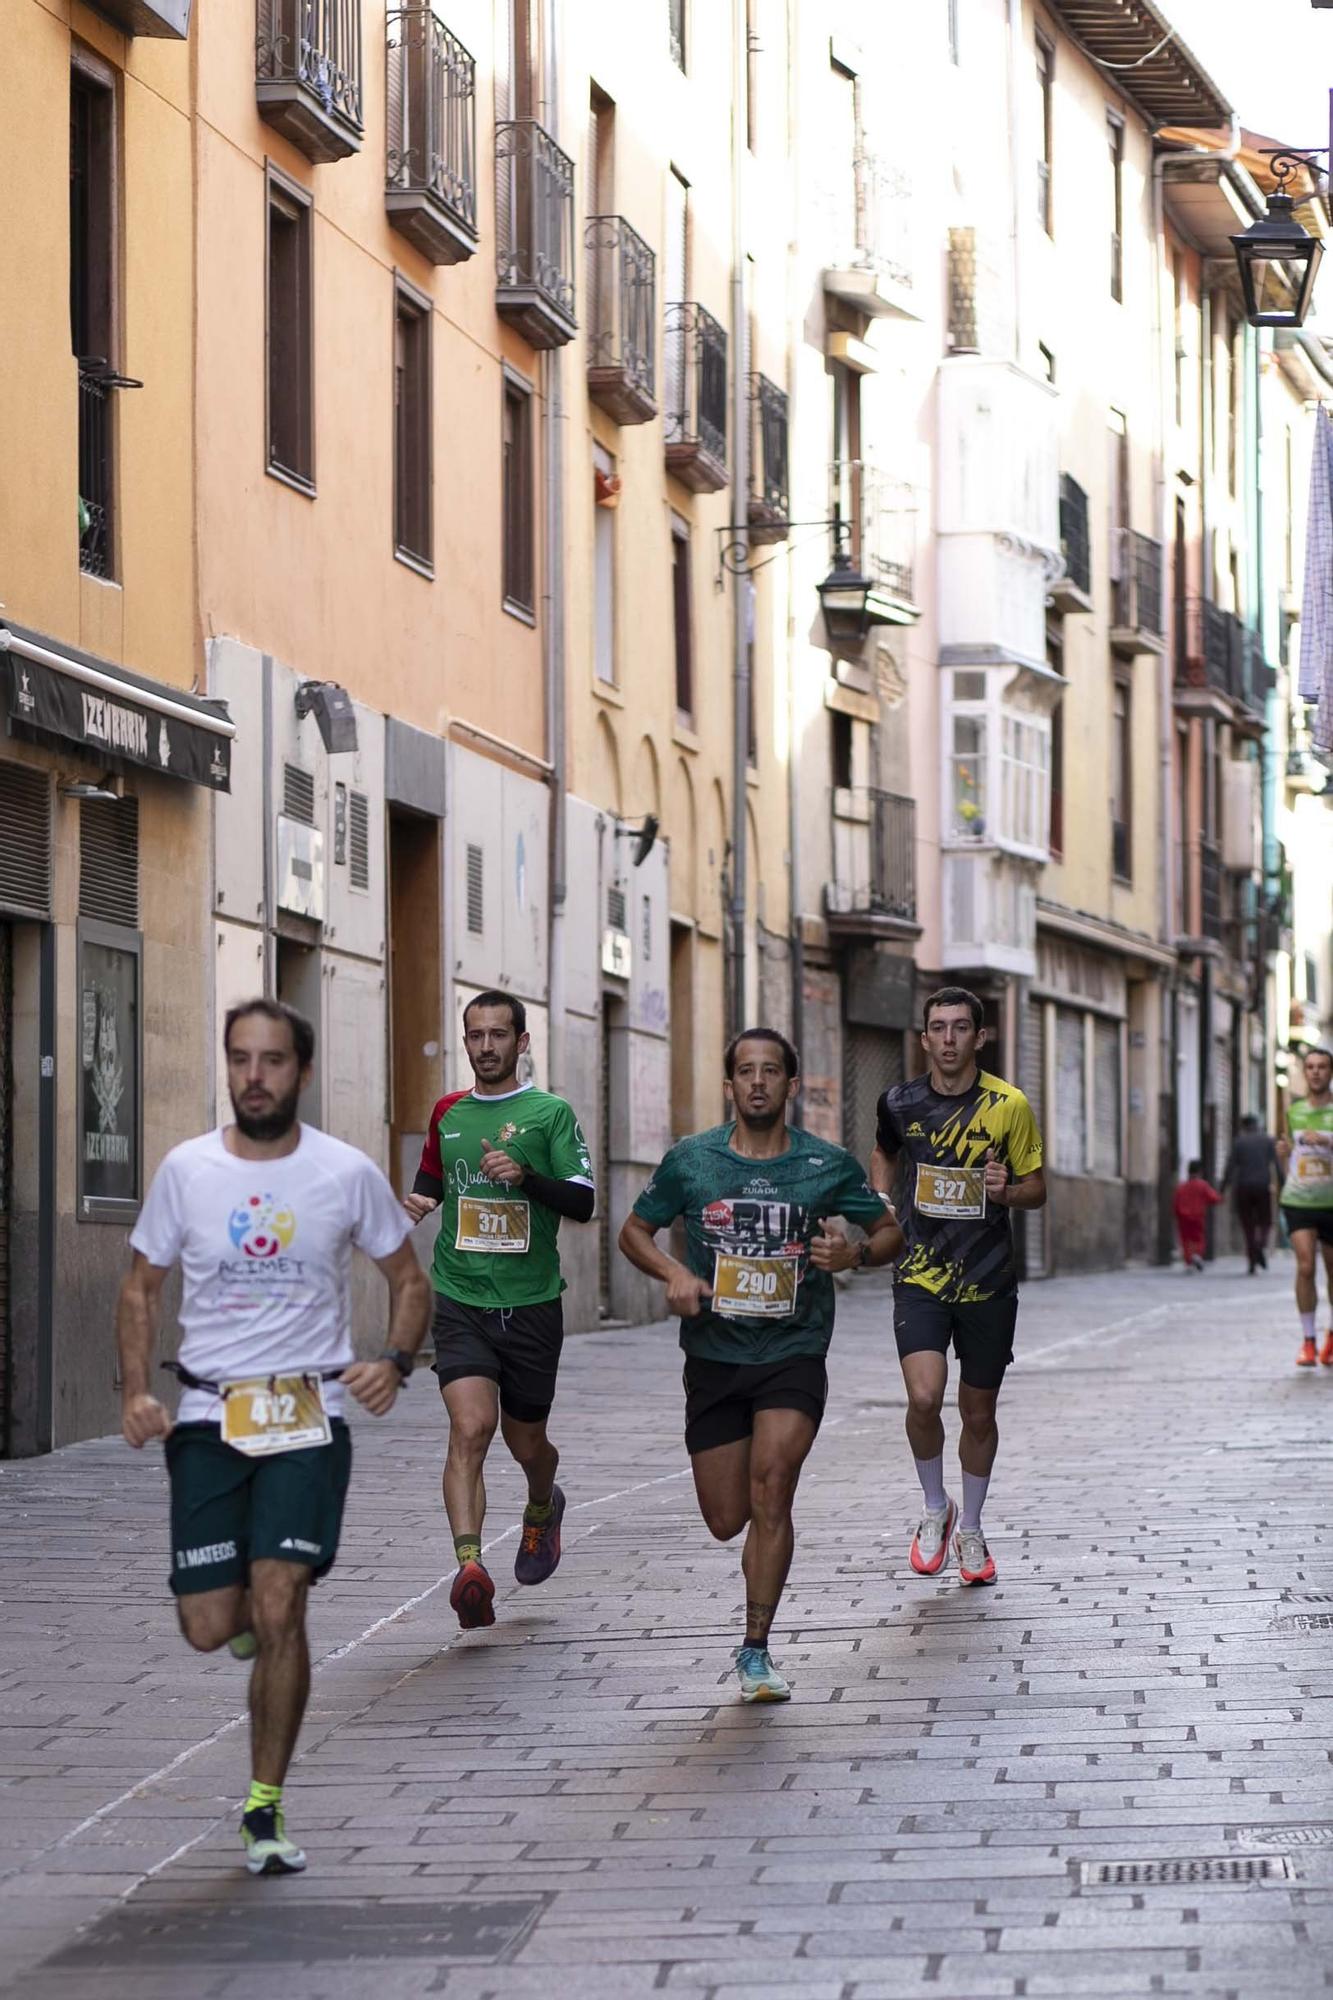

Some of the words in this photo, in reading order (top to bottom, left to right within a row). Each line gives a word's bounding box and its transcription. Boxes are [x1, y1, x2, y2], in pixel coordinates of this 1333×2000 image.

[934, 1179, 966, 1200] 327
[479, 1213, 507, 1233] 371
[736, 1271, 777, 1295] 290
[251, 1391, 297, 1425] 412
[187, 1540, 237, 1567] MATEOS
